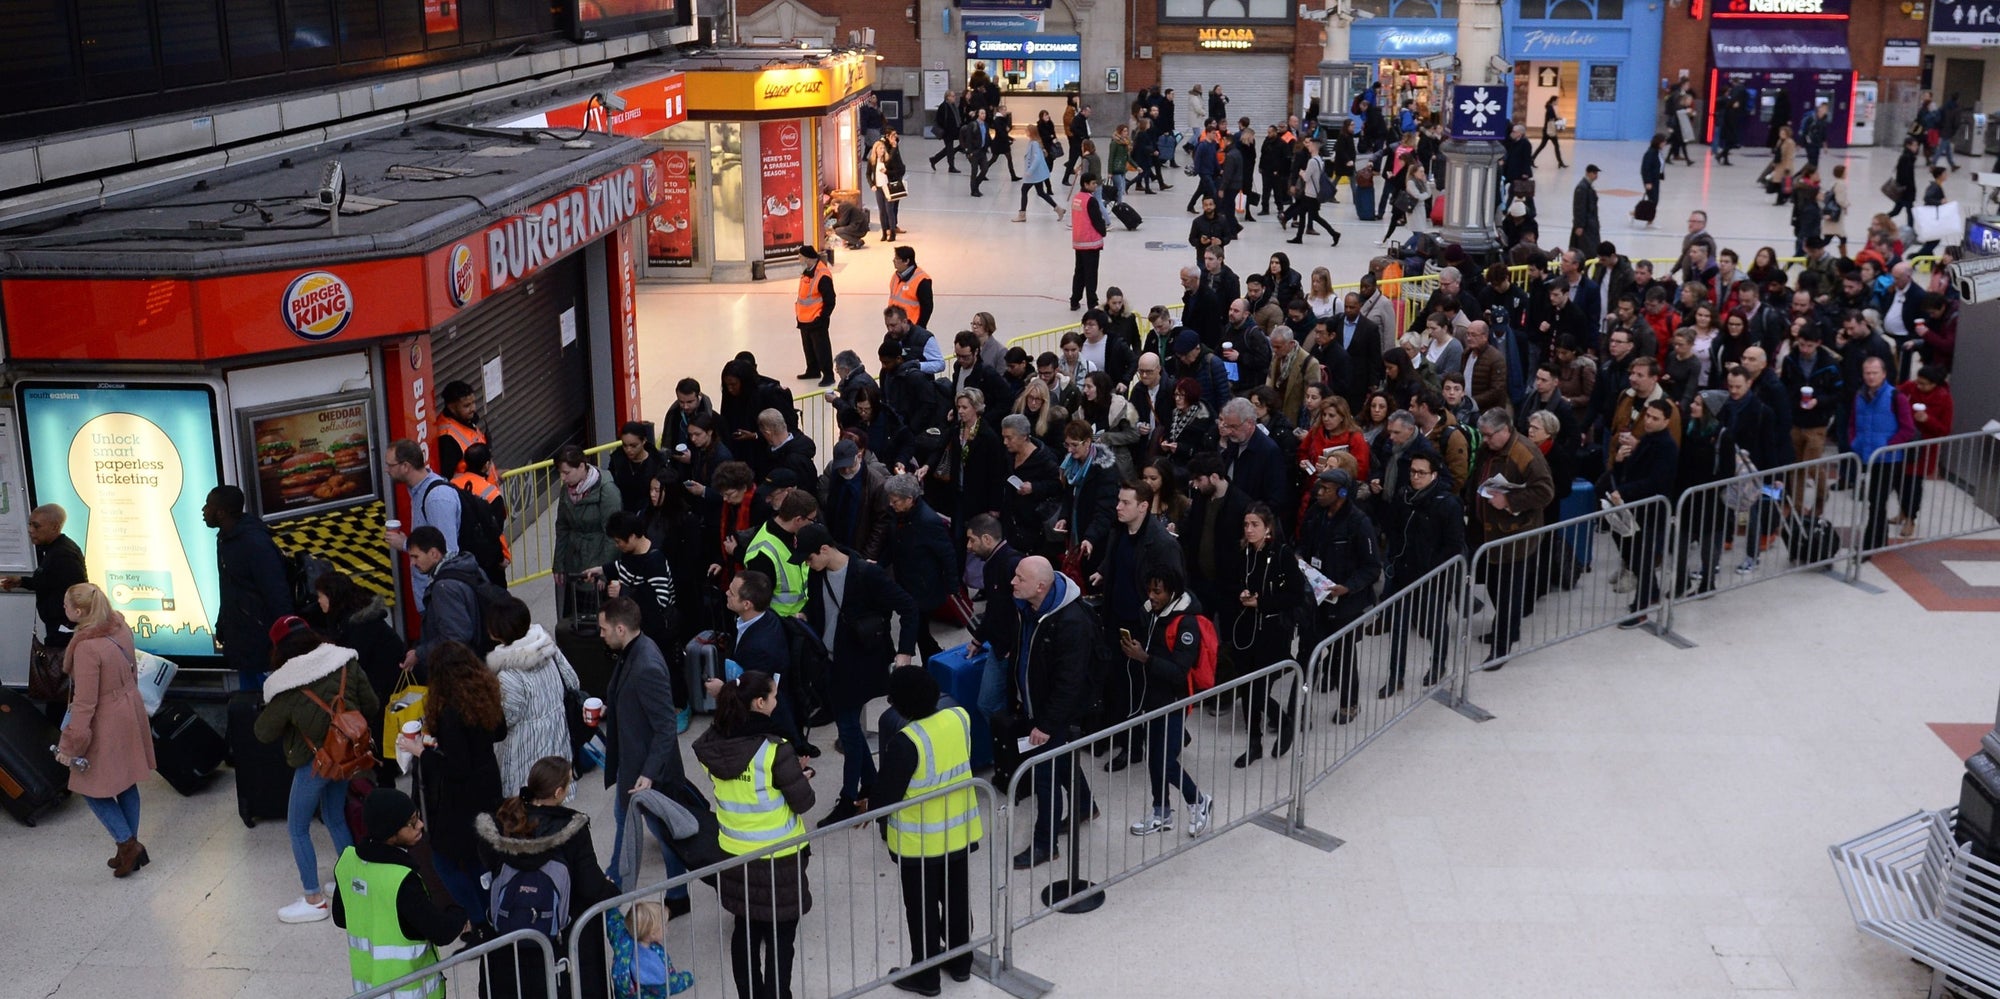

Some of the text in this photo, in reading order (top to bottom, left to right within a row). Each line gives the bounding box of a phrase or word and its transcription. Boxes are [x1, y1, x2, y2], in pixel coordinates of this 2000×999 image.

[1749, 0, 1823, 13] NatWest
[1199, 28, 1255, 40] MI CASA
[979, 43, 1078, 52] CURRENCY EXCHANGE
[1717, 43, 1846, 55] Free cash withdrawals
[764, 81, 823, 99] Upper Crust
[624, 107, 642, 121] EXPRESS
[763, 155, 783, 163] HERE'S
[769, 161, 800, 169] SPARKLING
[486, 168, 636, 291] BURGER KING
[1982, 229, 2000, 255] Ra
[292, 283, 343, 314] BURGER
[296, 294, 346, 331] KING
[622, 250, 637, 399] BURGER KING
[29, 391, 80, 401] southeastern
[318, 406, 362, 422] CHEDDAR
[320, 421, 361, 433] collection
[92, 433, 140, 445] Unlock
[93, 446, 135, 457] smart
[95, 458, 164, 472] paperless
[96, 473, 158, 488] ticketing
[109, 573, 141, 582] The Key
